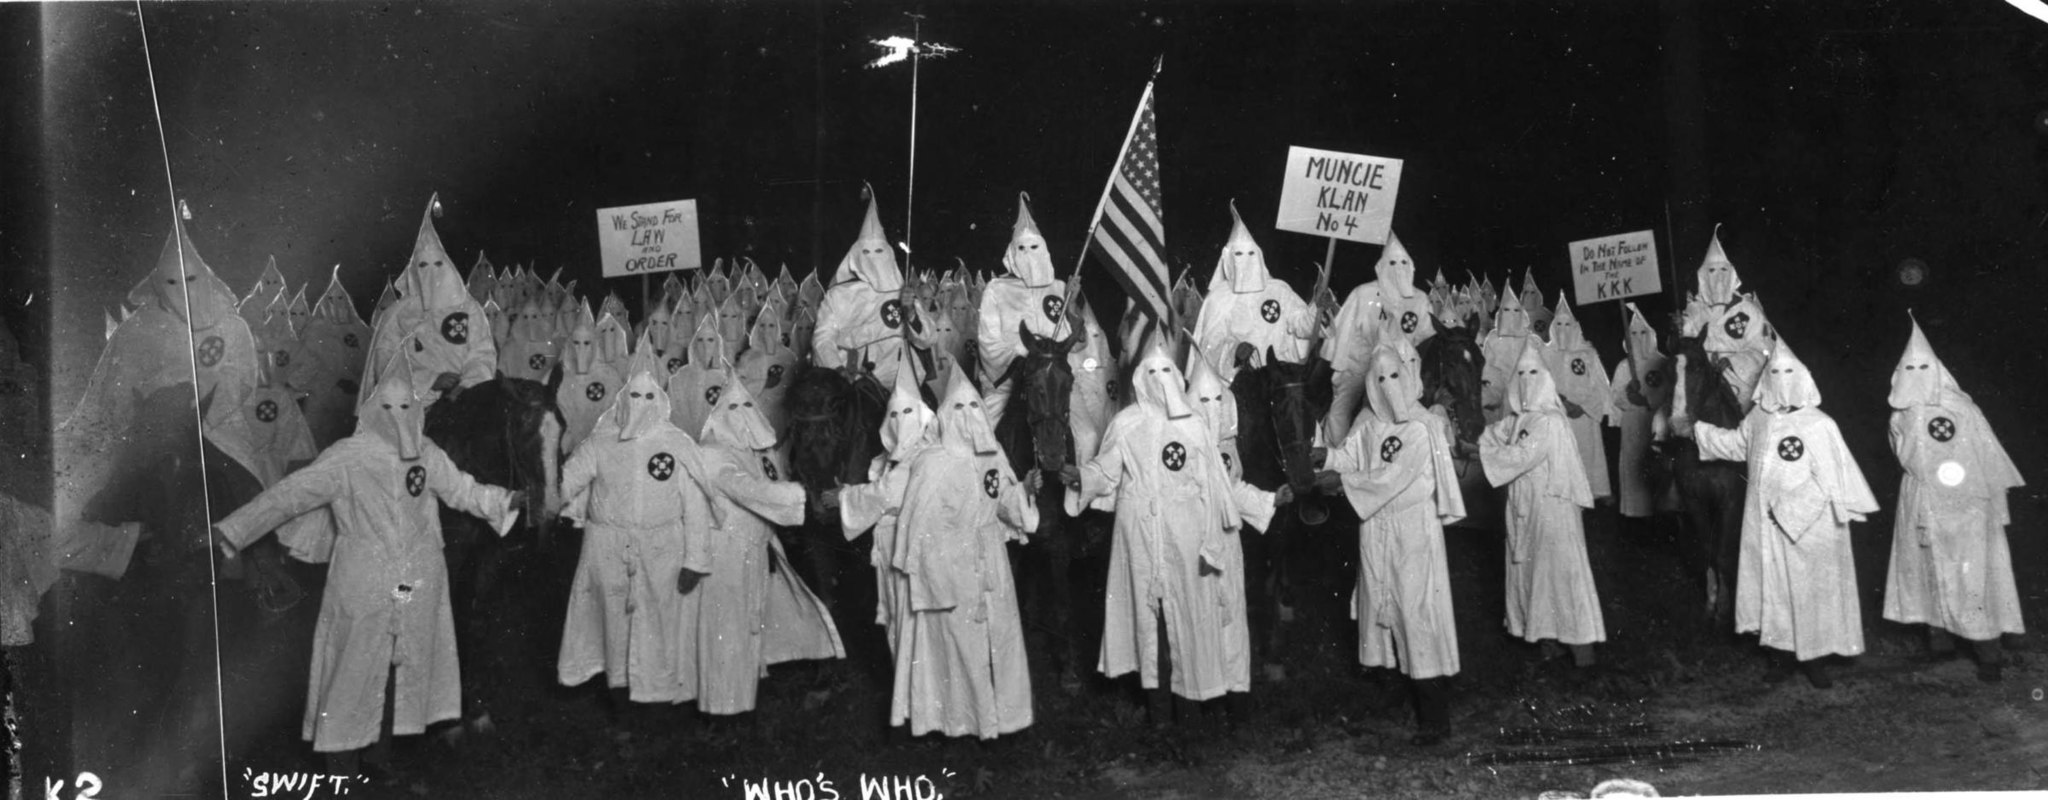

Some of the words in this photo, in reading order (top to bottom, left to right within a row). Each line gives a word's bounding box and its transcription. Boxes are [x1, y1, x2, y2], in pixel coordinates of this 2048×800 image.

[1305, 156, 1384, 190] MUNCIE
[1317, 186, 1368, 213] KLAN
[1344, 214, 1358, 236] 4
[631, 229, 665, 247] LAW
[625, 253, 678, 272] ORDER
